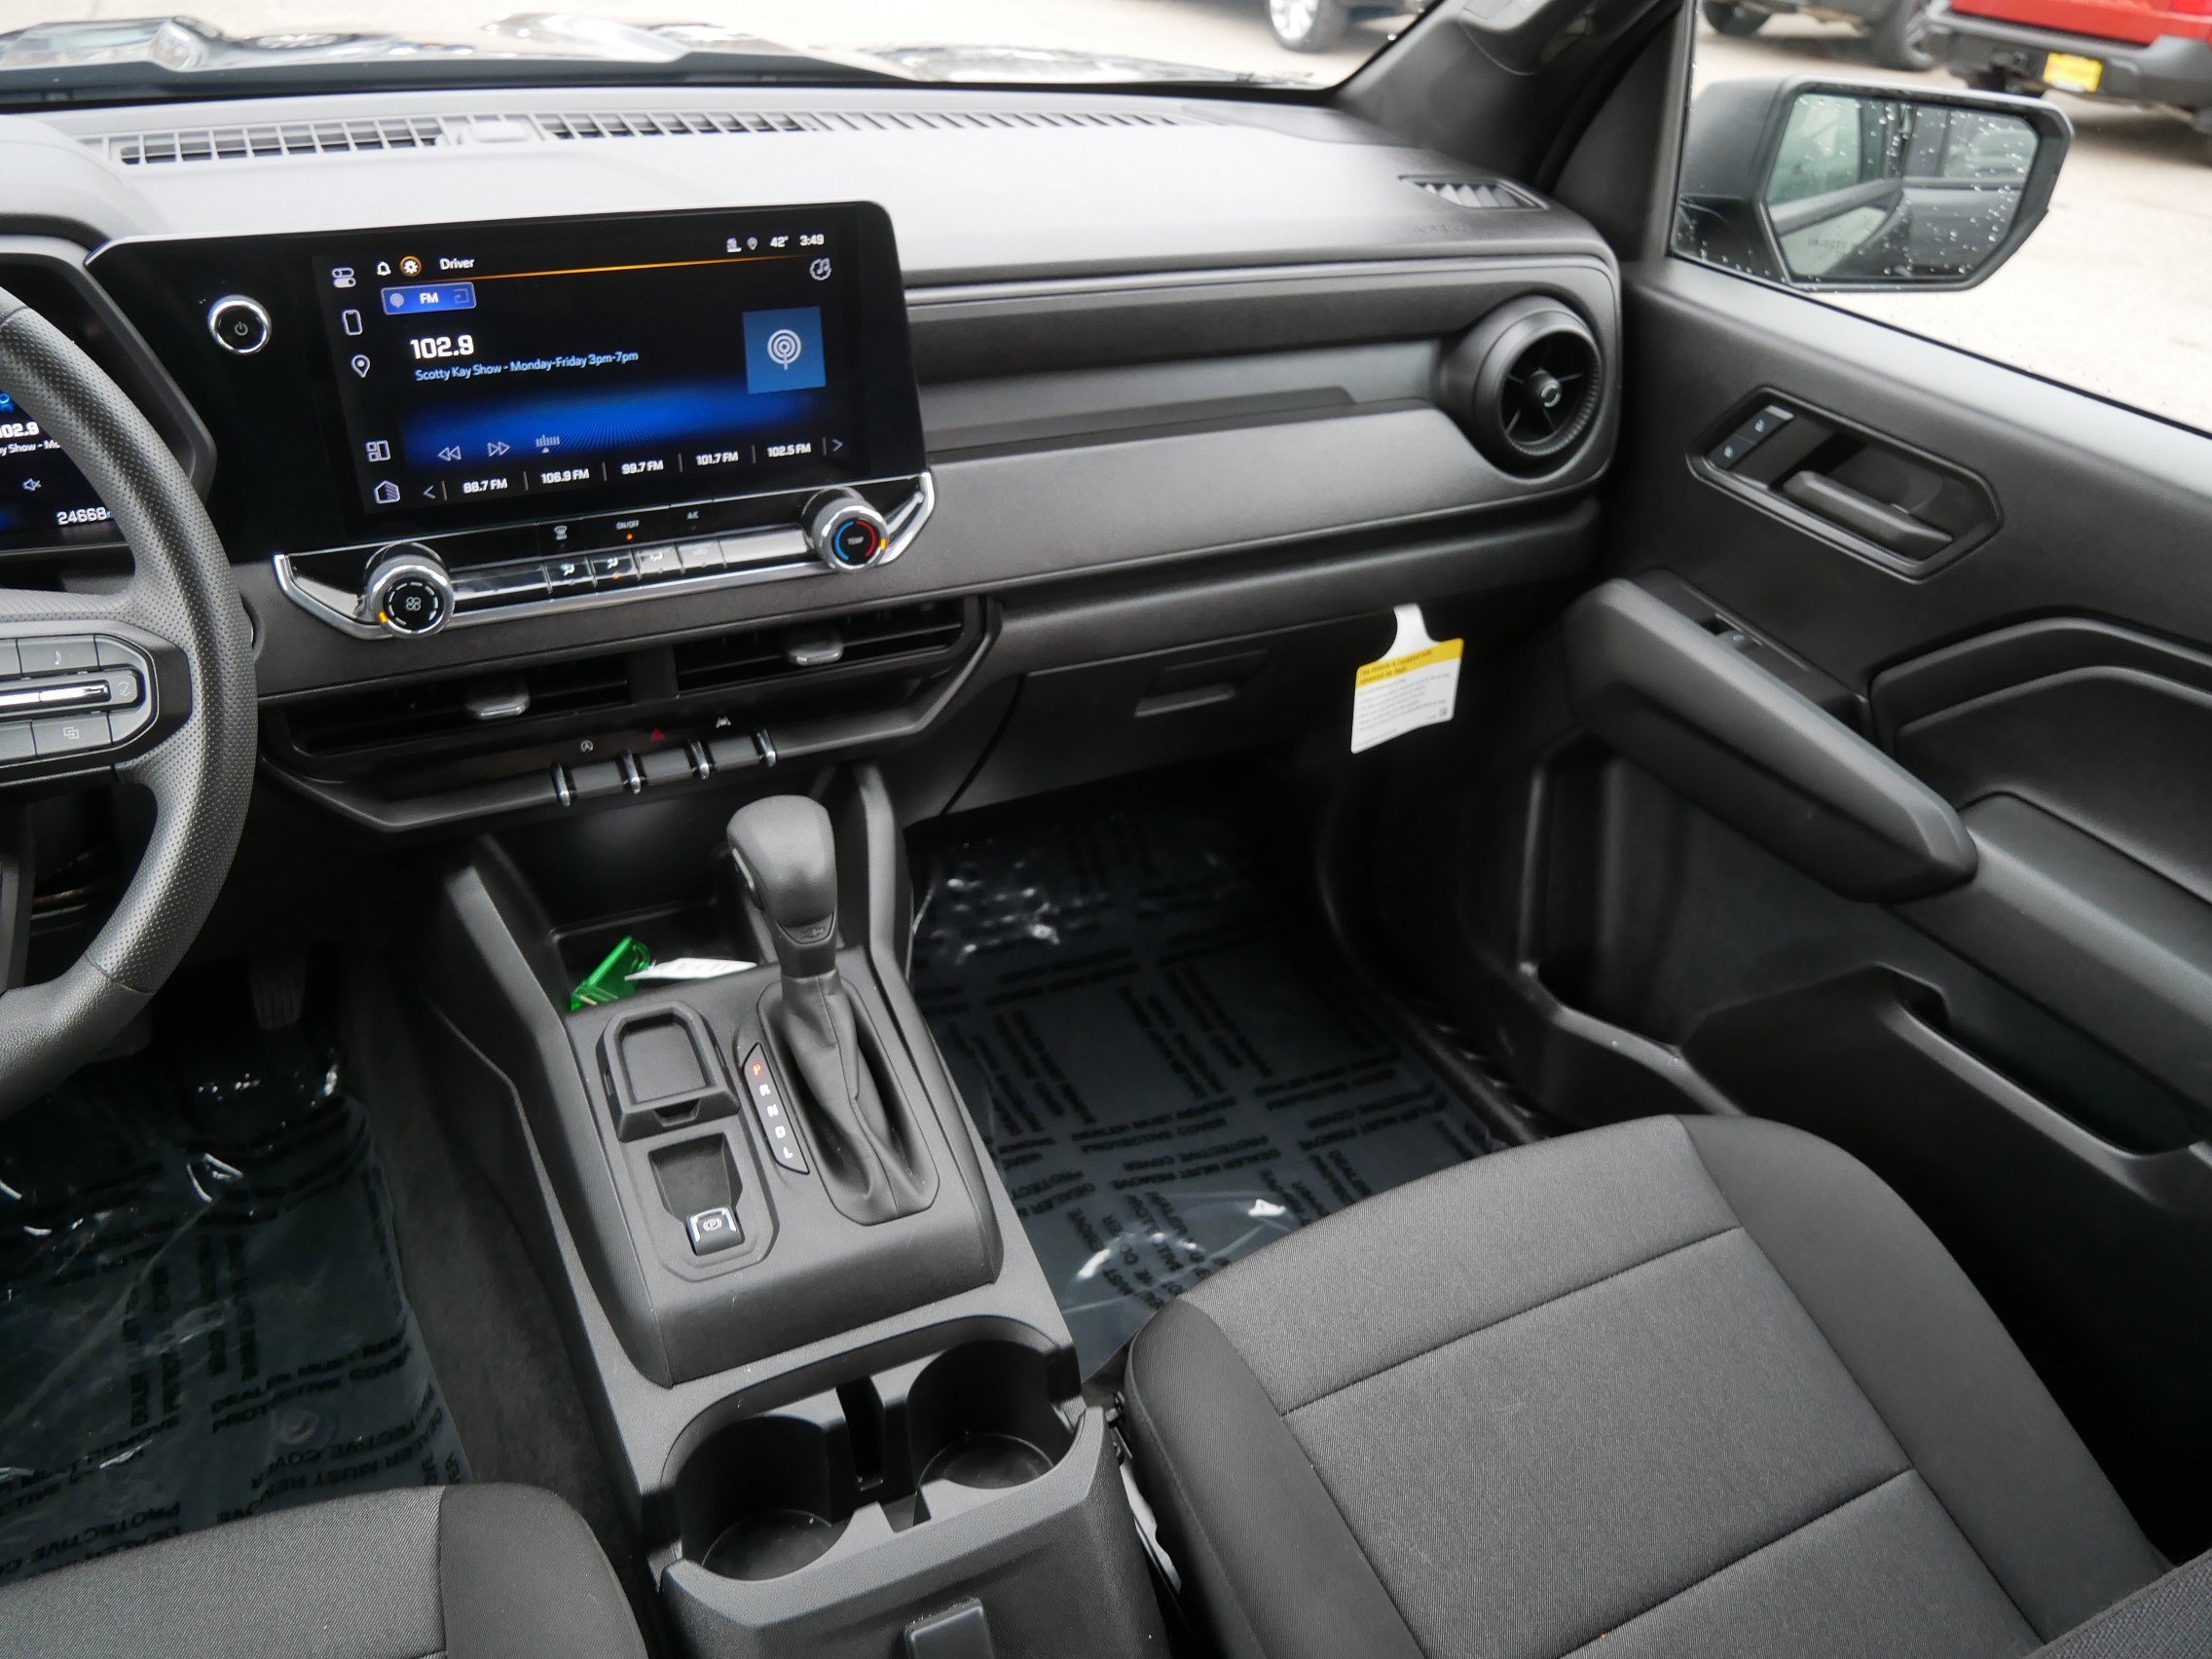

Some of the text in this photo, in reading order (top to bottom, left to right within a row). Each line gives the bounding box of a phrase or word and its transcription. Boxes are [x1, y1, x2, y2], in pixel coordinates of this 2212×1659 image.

[799, 234, 825, 246] 3:49
[439, 257, 475, 271] Driver
[419, 292, 439, 305] FM
[410, 334, 474, 359] 102.9
[415, 369, 450, 382] Scotty
[451, 366, 472, 381] Kay
[472, 363, 502, 376] Show
[509, 354, 587, 372] Monday-Friday
[588, 350, 639, 366] 3pm-7pm
[0, 421, 40, 438] 02.9
[10, 440, 36, 454] Show
[794, 443, 811, 456] FM
[696, 451, 739, 466] 101.7 FM
[646, 460, 664, 472] FM
[572, 468, 590, 481] FM
[490, 478, 508, 492] FM
[753, 1063, 761, 1076] P
[759, 1084, 771, 1097] R
[767, 1103, 779, 1118] N
[775, 1125, 786, 1139] D
[783, 1146, 793, 1159] L
